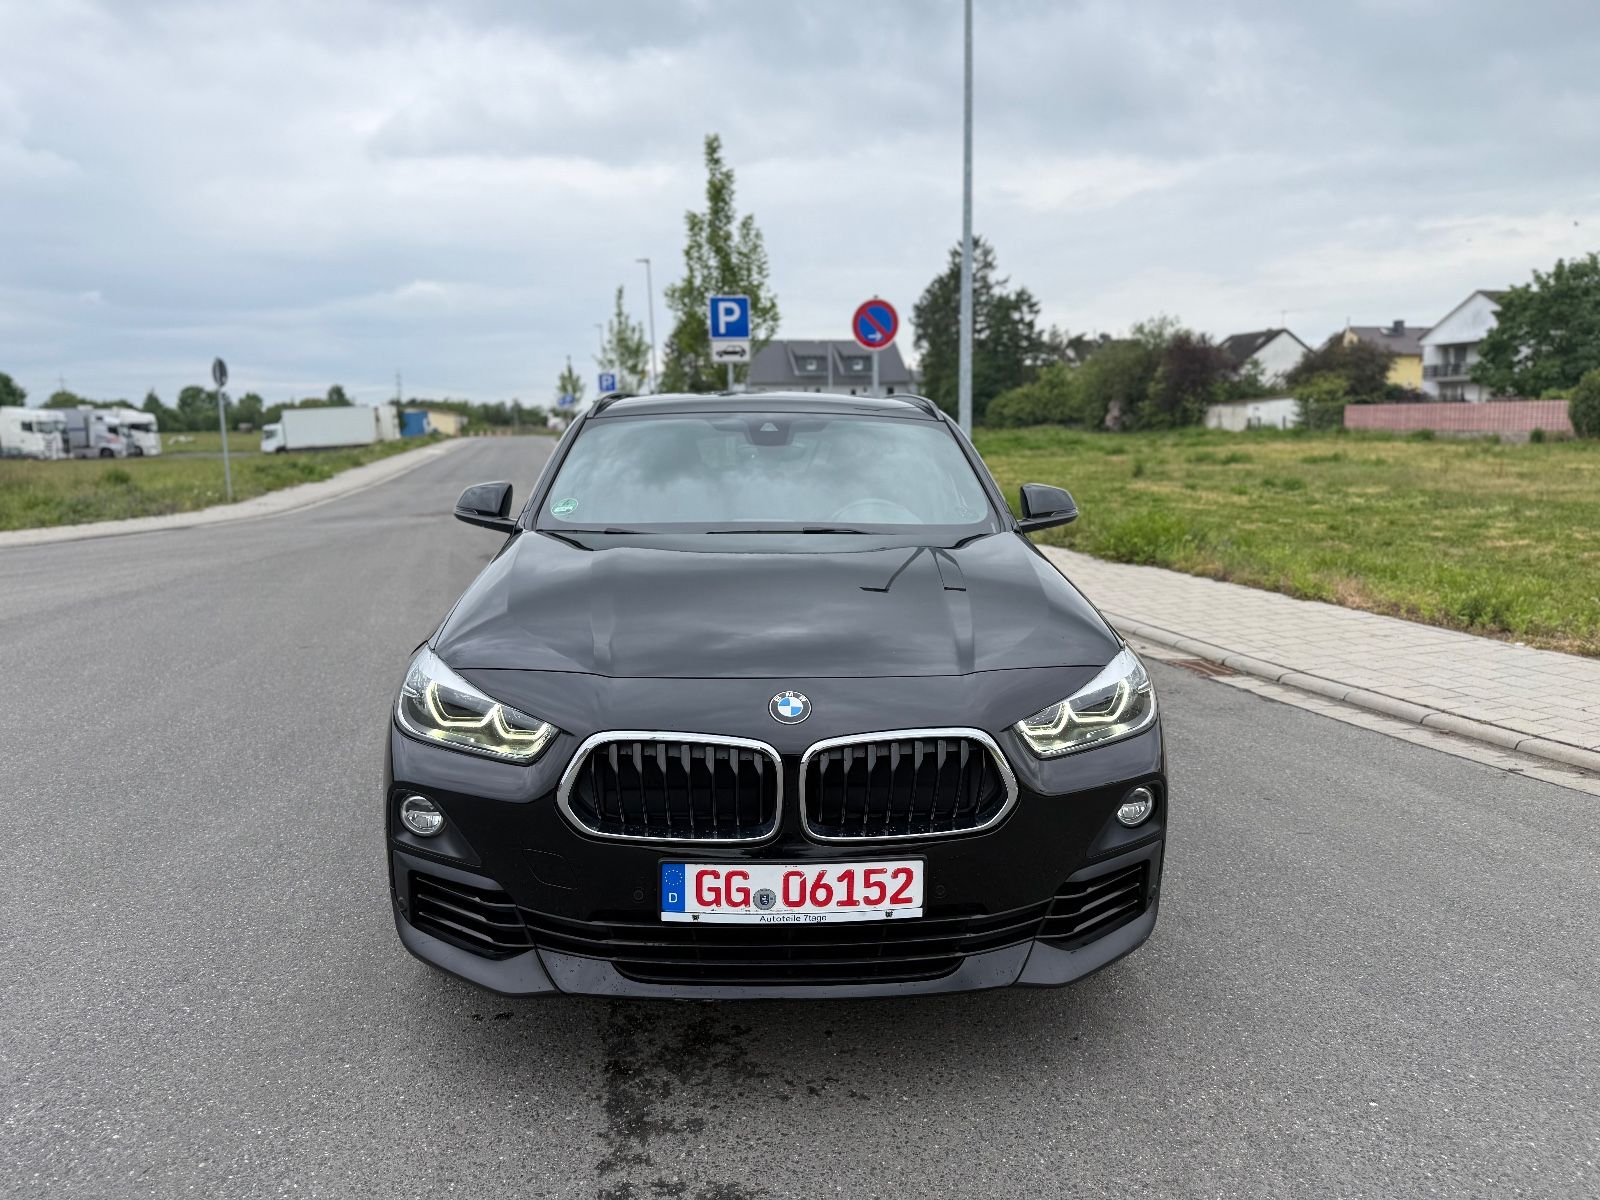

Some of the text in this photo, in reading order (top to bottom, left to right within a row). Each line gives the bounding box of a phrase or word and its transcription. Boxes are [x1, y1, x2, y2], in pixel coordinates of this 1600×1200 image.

[718, 301, 741, 334] P
[601, 375, 614, 390] P
[773, 691, 807, 702] BMW
[695, 869, 751, 908] GG
[782, 867, 914, 908] 06152
[668, 892, 679, 903] D
[759, 914, 801, 922] Autoteile
